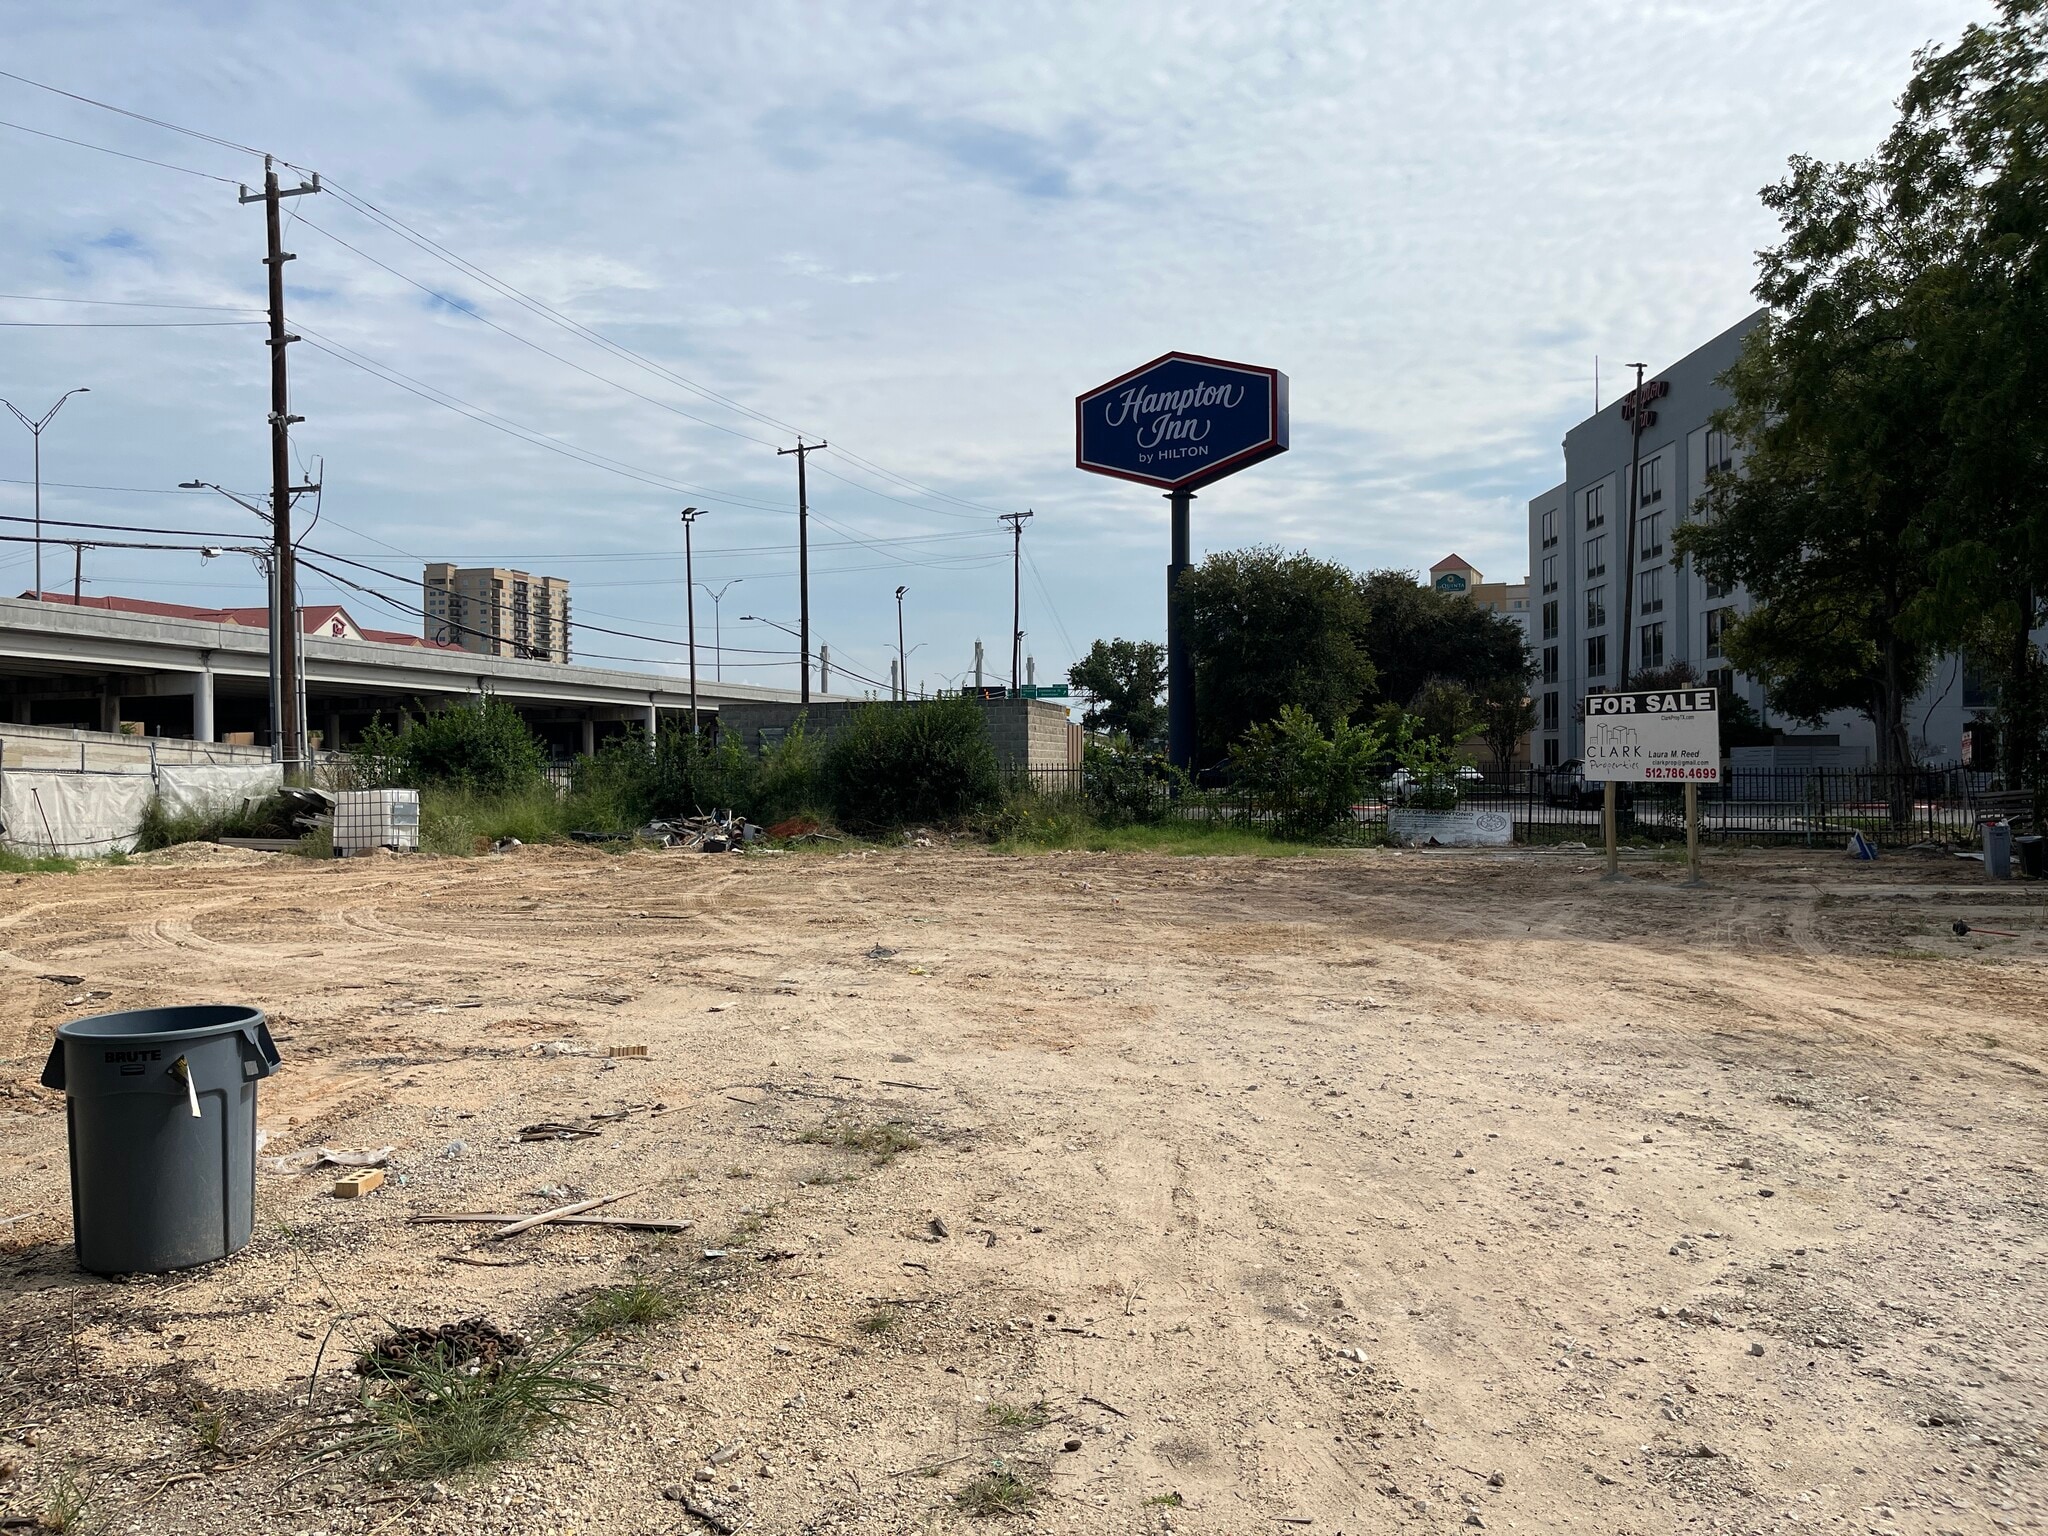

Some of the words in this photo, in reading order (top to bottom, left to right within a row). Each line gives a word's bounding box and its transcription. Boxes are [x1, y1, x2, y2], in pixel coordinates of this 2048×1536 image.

[1106, 381, 1244, 426] Hampton
[1137, 413, 1211, 448] Inn
[1139, 453, 1153, 463] by
[1158, 445, 1208, 460] HILTON
[1589, 696, 1636, 714] FOR
[1646, 692, 1711, 712] SALE
[1586, 745, 1642, 758] CLARK
[1648, 750, 1668, 758] Laura
[1670, 750, 1679, 758] M.
[1680, 750, 1700, 758] Reed
[1590, 760, 1639, 774] Properties
[1645, 767, 1717, 778] 512.786.4699
[104, 1050, 161, 1063] BRUTE
